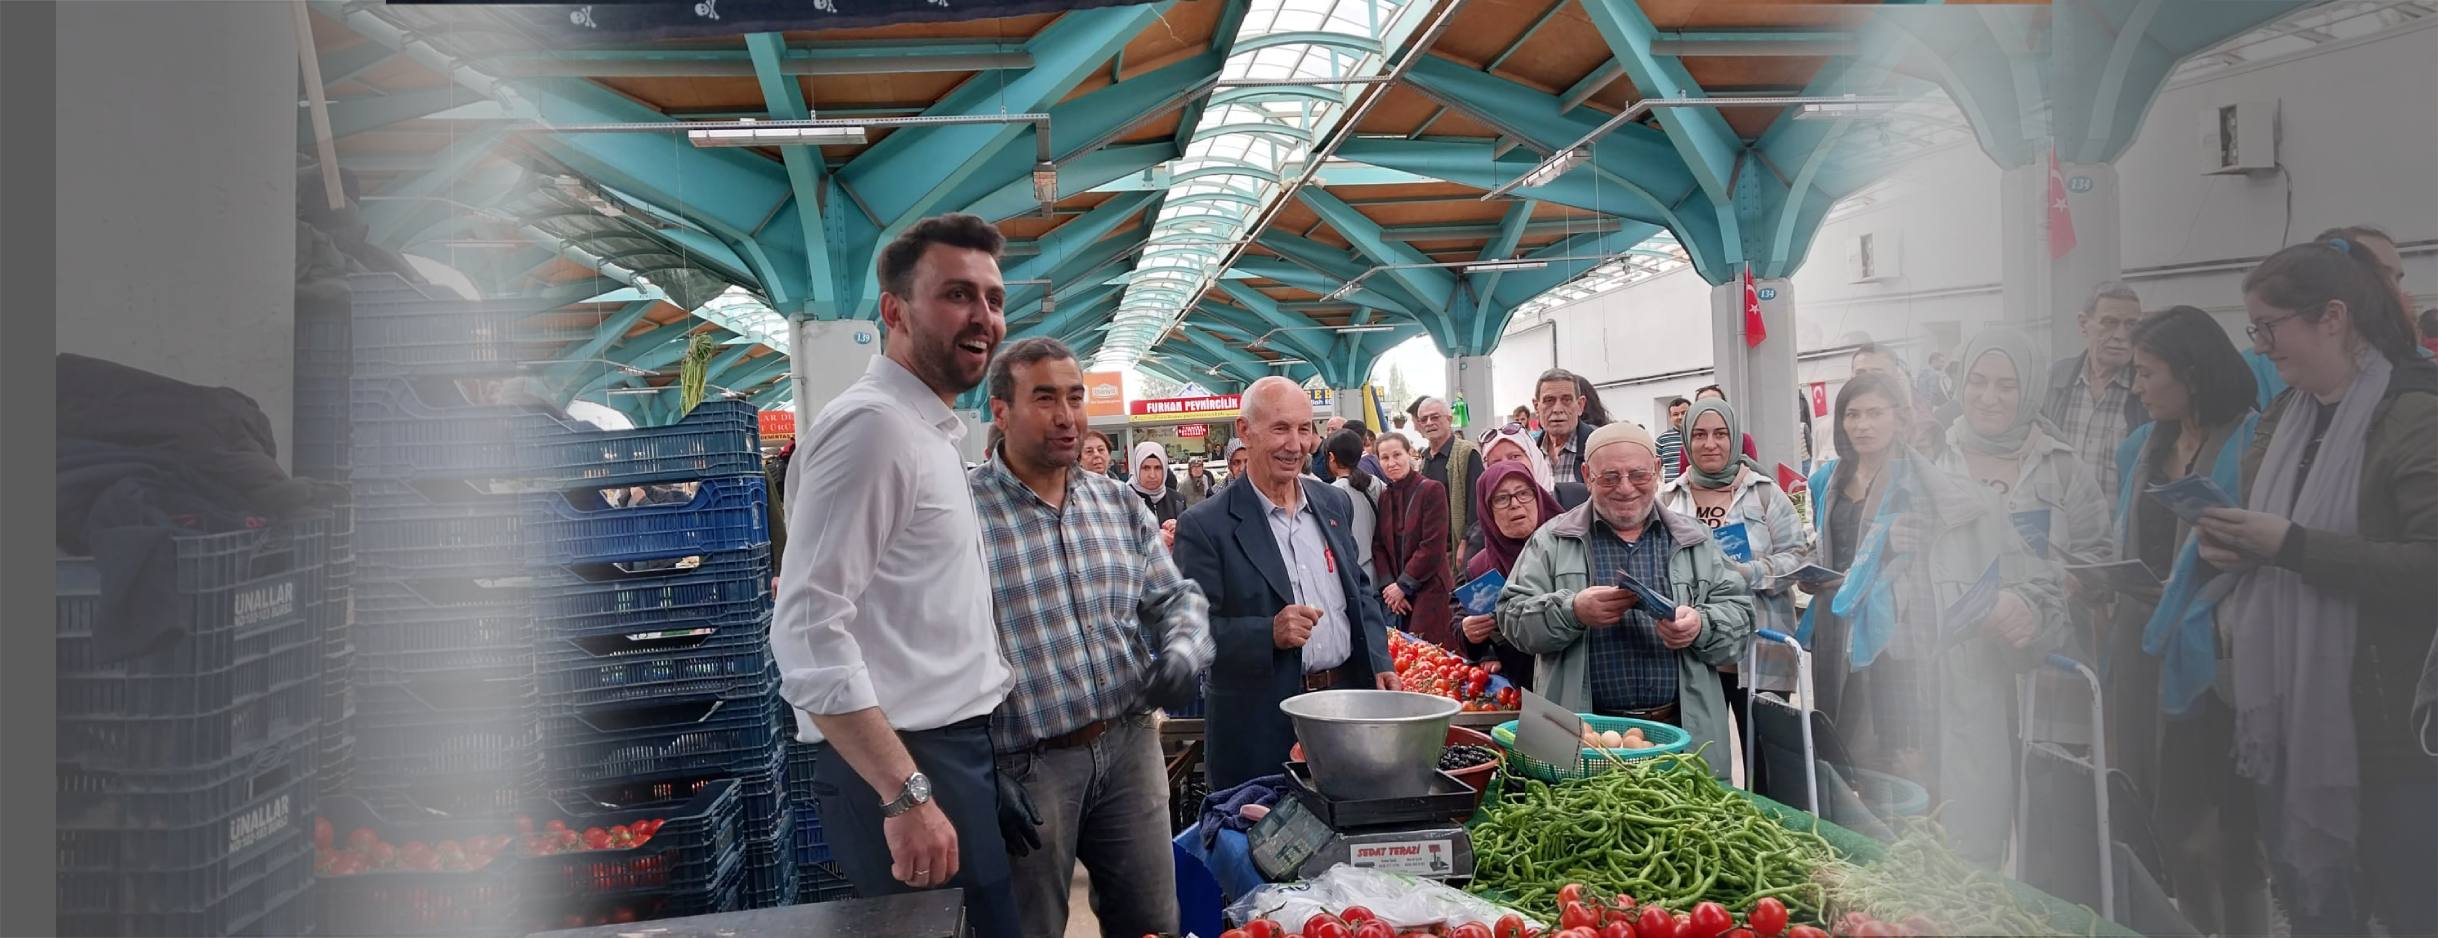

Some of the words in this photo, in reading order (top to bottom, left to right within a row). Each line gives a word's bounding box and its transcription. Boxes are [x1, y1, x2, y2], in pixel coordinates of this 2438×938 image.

[1760, 289, 1775, 298] 134
[857, 333, 870, 343] 139
[1146, 401, 1182, 413] FURKAN
[1696, 506, 1726, 518] MO
[1358, 848, 1387, 857] SEDAT
